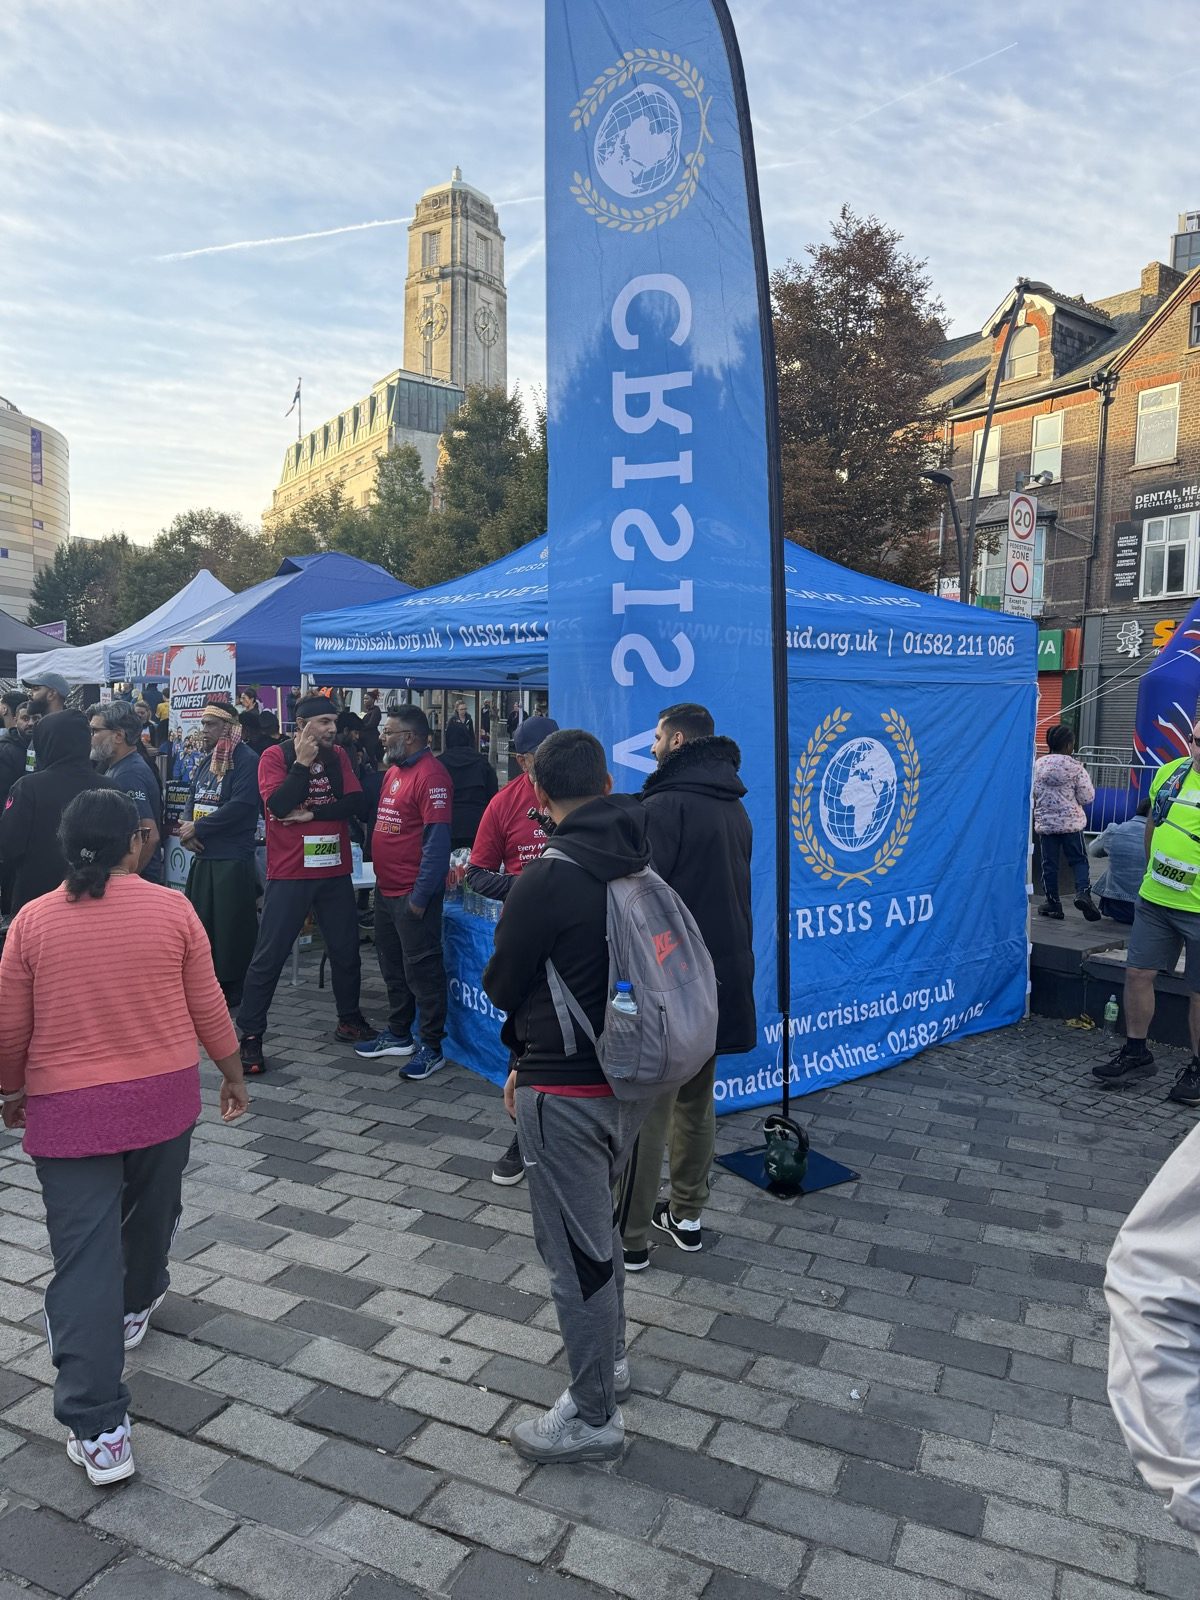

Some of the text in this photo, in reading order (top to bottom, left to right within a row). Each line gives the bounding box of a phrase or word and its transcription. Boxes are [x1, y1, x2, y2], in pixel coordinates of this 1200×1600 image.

[1135, 489, 1178, 504] DENTAL
[1135, 497, 1181, 509] SPECIALISTS
[1015, 509, 1031, 528] 20
[1010, 543, 1033, 551] PEDESTRIAN
[1012, 550, 1029, 560] ZONE
[850, 594, 922, 609] LIVES
[314, 626, 442, 653] www.crisisaid.org.uk
[459, 624, 510, 648] 01582
[509, 620, 545, 644] 211
[903, 631, 952, 656] 01582
[956, 635, 984, 656] 211
[987, 635, 1015, 656] 066
[201, 673, 233, 691] LUTON
[173, 694, 206, 708] RUNFEST
[517, 844, 537, 852] Every
[519, 853, 537, 861] Every
[1156, 863, 1186, 882] 2683
[789, 894, 934, 940] RISIS AID
[802, 1042, 886, 1079] Hotline:
[887, 1021, 938, 1055] 01582
